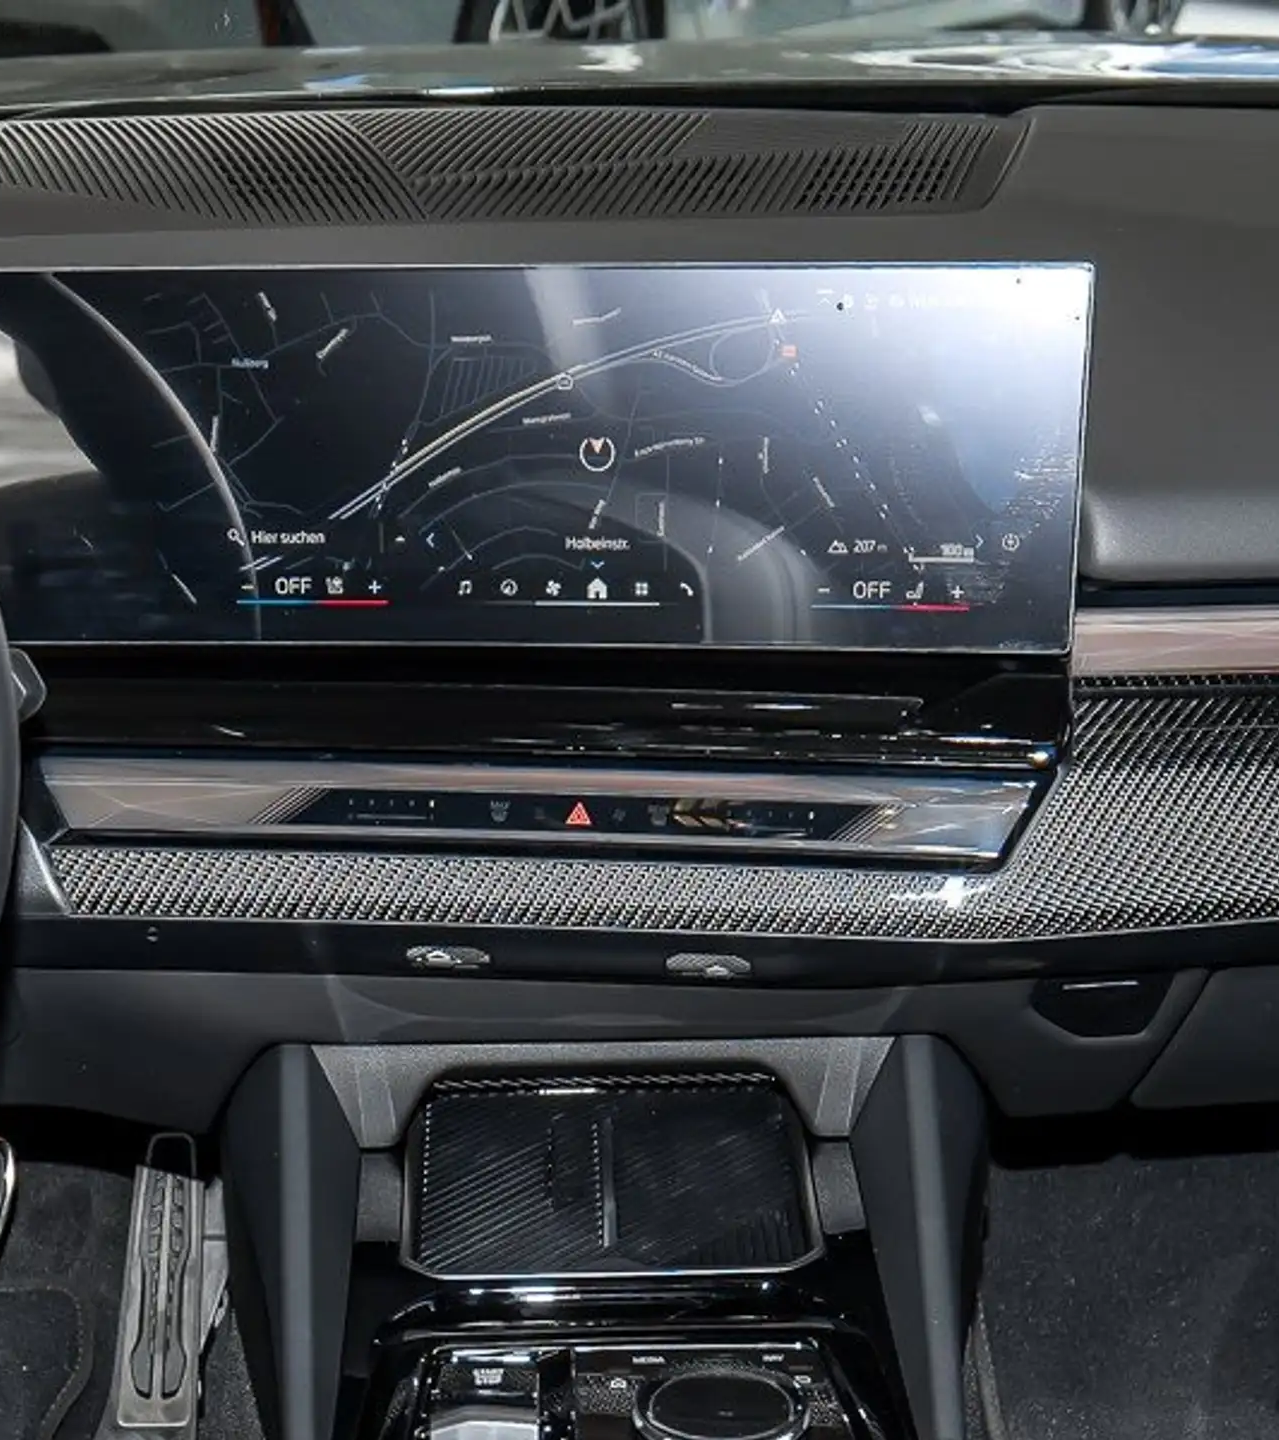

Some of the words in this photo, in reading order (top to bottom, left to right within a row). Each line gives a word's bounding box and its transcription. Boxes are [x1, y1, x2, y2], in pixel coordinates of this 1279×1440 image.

[250, 530, 278, 543] Hier
[280, 530, 326, 543] suchen
[274, 576, 312, 594] OFF
[853, 580, 891, 599] OFF
